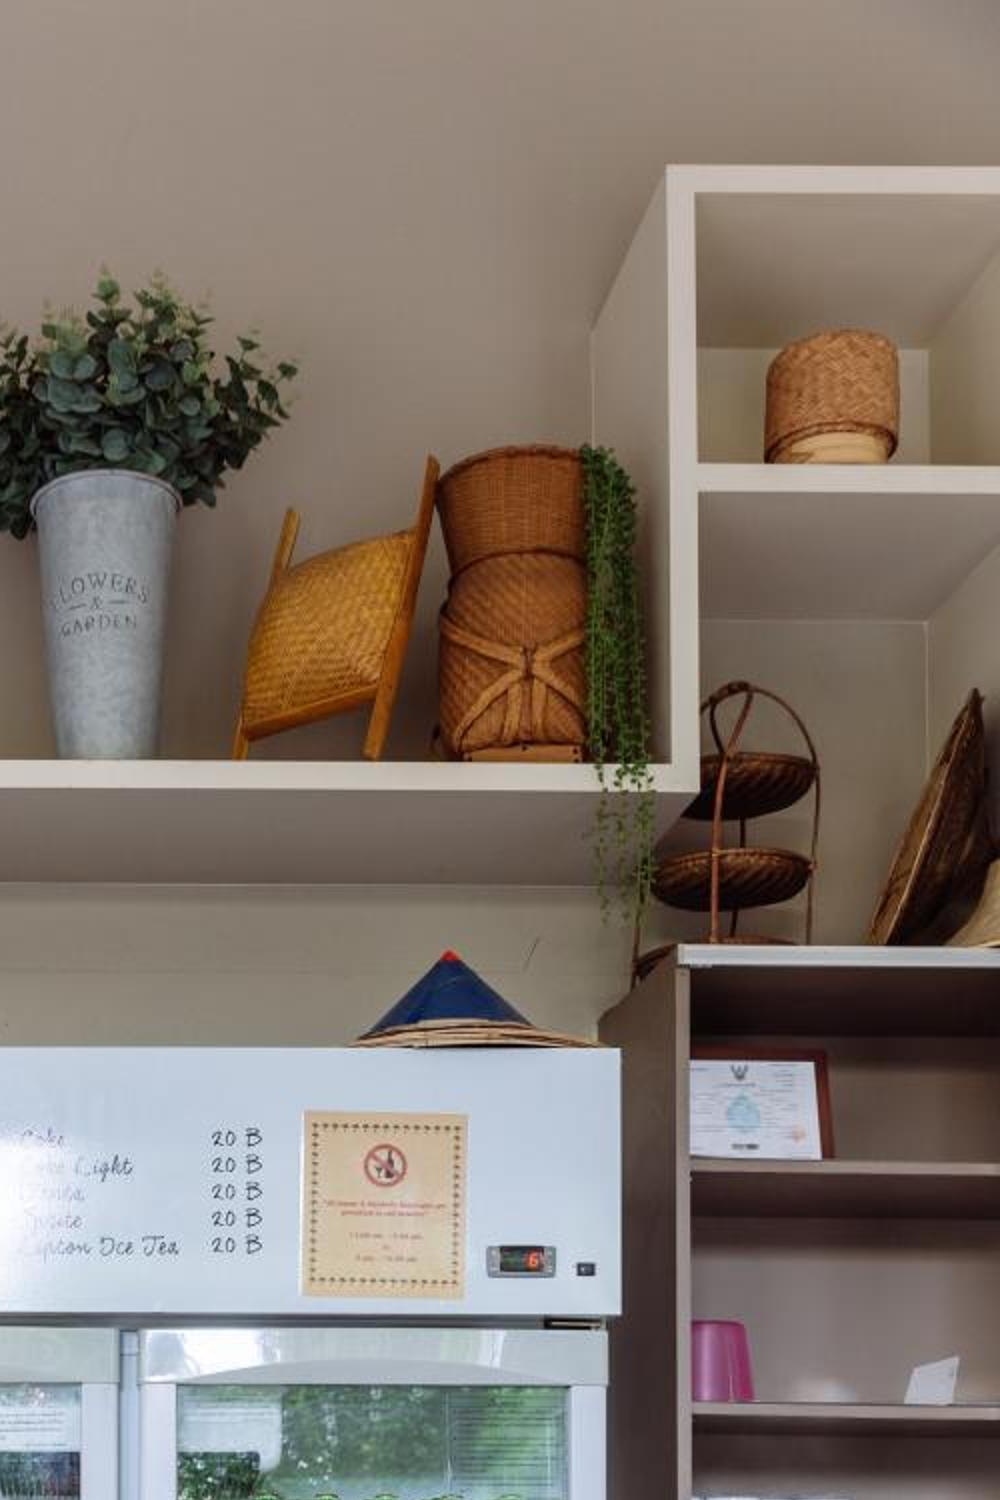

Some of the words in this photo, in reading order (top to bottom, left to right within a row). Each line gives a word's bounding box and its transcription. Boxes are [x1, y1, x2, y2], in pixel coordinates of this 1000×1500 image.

[61, 614, 138, 638] GARDEN
[211, 1130, 237, 1147] 20
[245, 1127, 263, 1147] B
[211, 1157, 237, 1173] 20
[245, 1153, 263, 1174] B
[211, 1183, 237, 1200] 20
[245, 1181, 263, 1201] B
[211, 1210, 237, 1227] 20
[245, 1207, 263, 1228] B
[100, 1236, 135, 1257] Ice
[141, 1234, 181, 1257] Tea
[211, 1237, 237, 1253] 20
[245, 1234, 263, 1255] B
